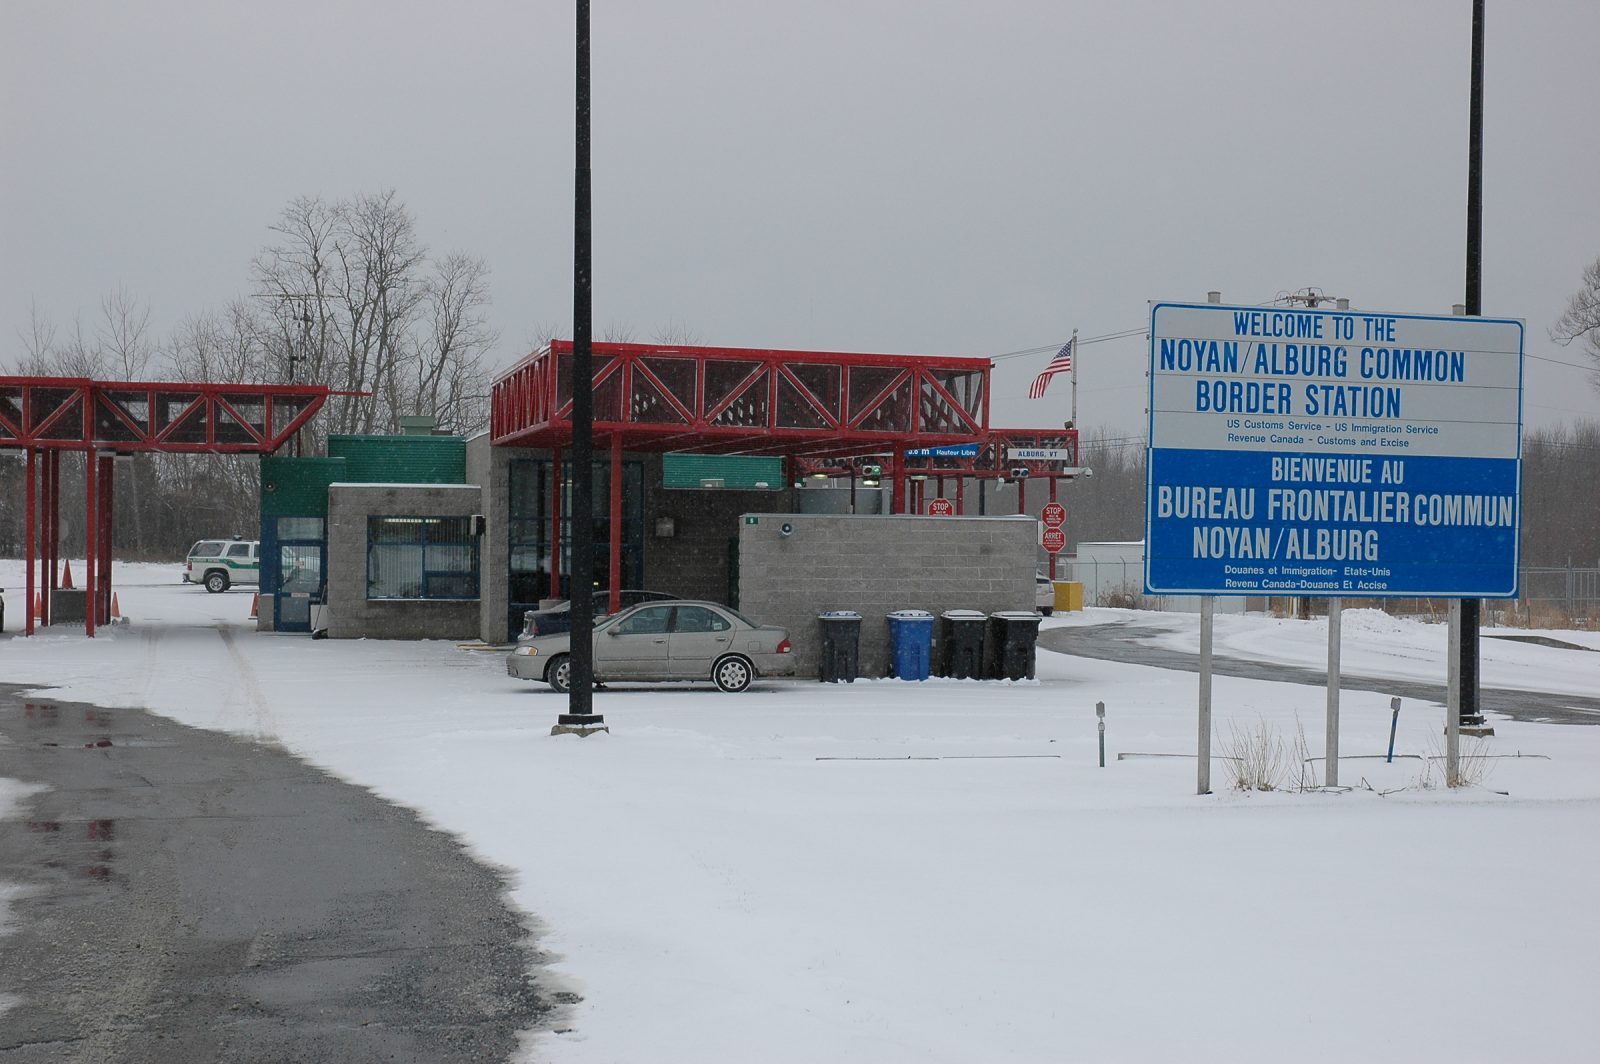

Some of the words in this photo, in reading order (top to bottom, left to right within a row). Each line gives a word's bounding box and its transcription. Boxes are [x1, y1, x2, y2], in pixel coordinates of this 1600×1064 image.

[1234, 311, 1323, 339] WELCOME
[1334, 316, 1353, 340] TO
[1363, 318, 1396, 342] THE
[1160, 339, 1347, 378] NOYAN/ALBURG
[1361, 348, 1464, 382] COMMON
[1196, 380, 1291, 415] BORDER
[1305, 384, 1400, 418] STATION
[1227, 420, 1241, 429] US
[1244, 420, 1284, 430] Customs
[1288, 421, 1322, 431] Service
[1335, 423, 1348, 432] US
[1351, 423, 1401, 435] Immigration
[1406, 425, 1438, 434] Service
[1228, 434, 1265, 444] Revenue
[1270, 435, 1304, 444] Canada
[1317, 436, 1356, 446] Customs
[1360, 437, 1377, 446] and
[1380, 438, 1409, 448] Excise
[1017, 450, 1047, 458] ALBURG,
[1049, 450, 1058, 458] VT
[1272, 457, 1372, 484] BIENVENUE
[1381, 461, 1404, 484] AU
[932, 502, 949, 511] STOP
[1158, 486, 1254, 520] BUREAU
[1268, 489, 1409, 523] FRONTALIER
[1414, 494, 1512, 527] COMMUN
[1193, 527, 1378, 561] NOYAN/ALBURG
[1225, 565, 1264, 575] Douanes
[1268, 566, 1277, 575] et
[1344, 566, 1390, 576] Etats-Unis
[1226, 579, 1259, 588] Revenu
[1262, 579, 1339, 589] Canada-Douanes
[1343, 580, 1352, 589] Et
[1358, 580, 1387, 590] Accise
